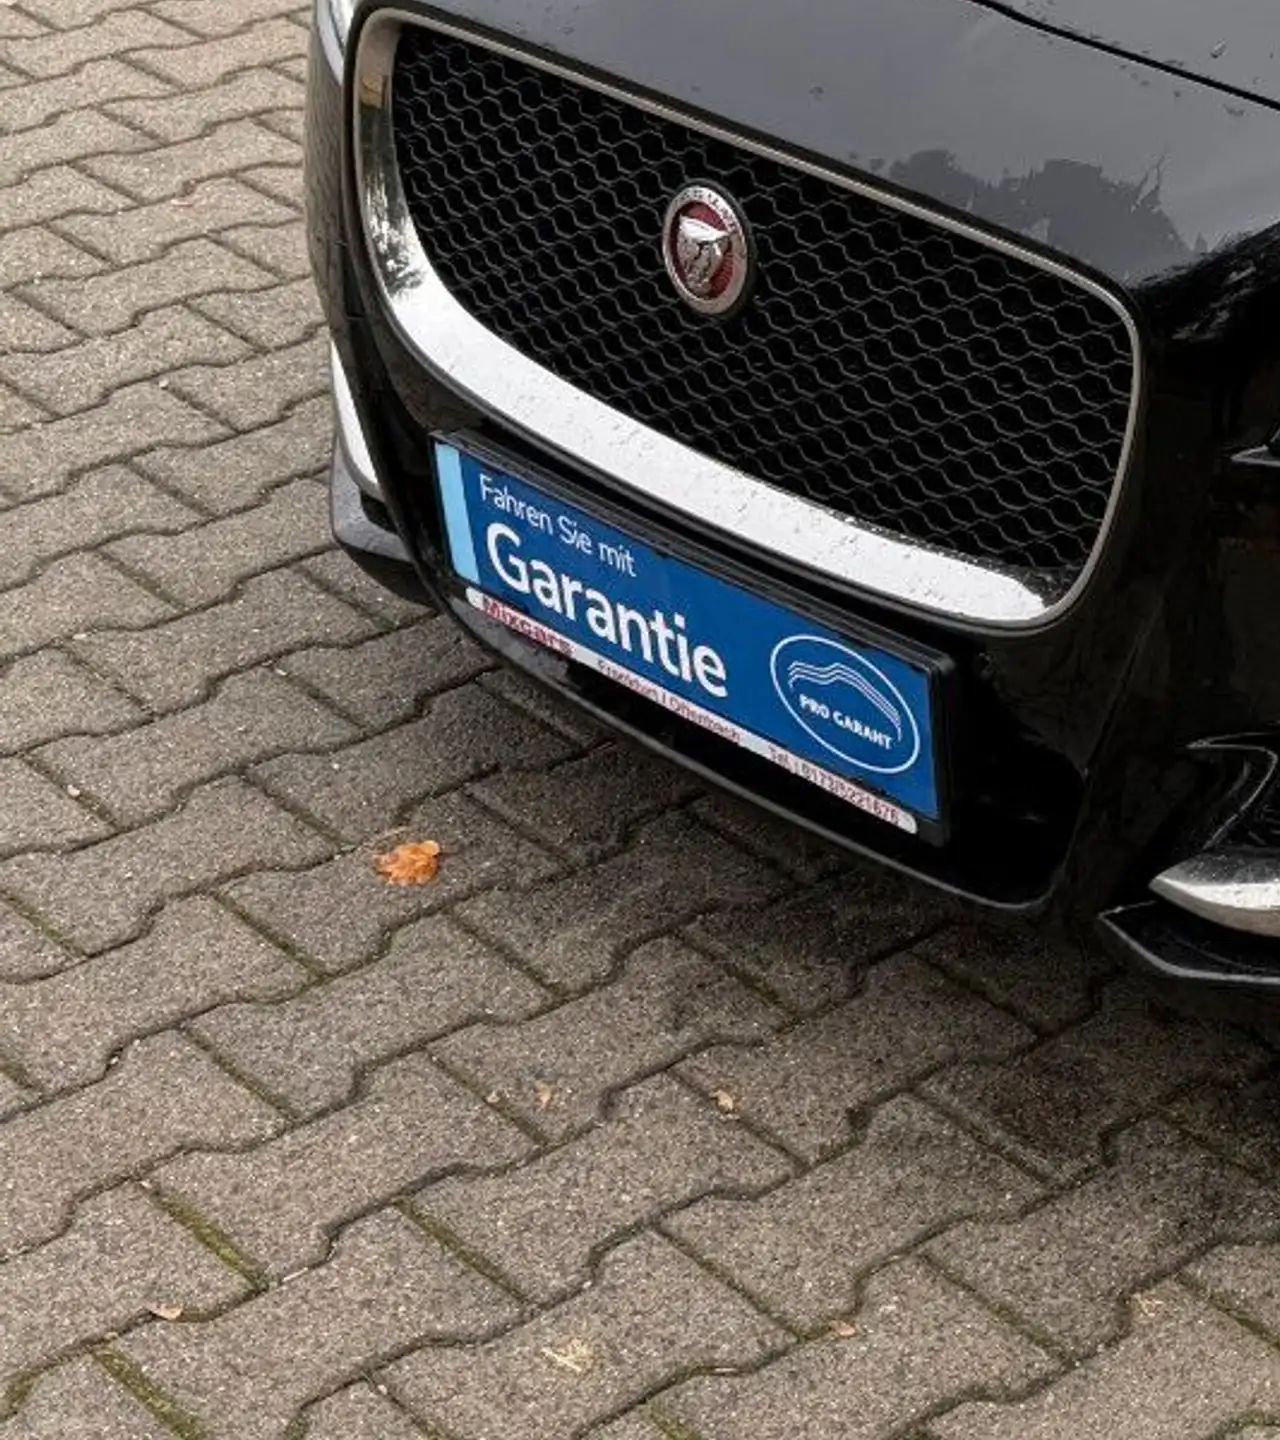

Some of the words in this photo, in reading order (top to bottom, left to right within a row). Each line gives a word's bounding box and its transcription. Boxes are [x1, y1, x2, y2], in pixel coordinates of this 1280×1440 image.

[479, 472, 553, 536] Fahren
[557, 515, 593, 556] Sie
[599, 541, 637, 578] mit
[486, 522, 729, 699] Garantie
[799, 693, 830, 720] PRO
[832, 710, 893, 750] GARANT
